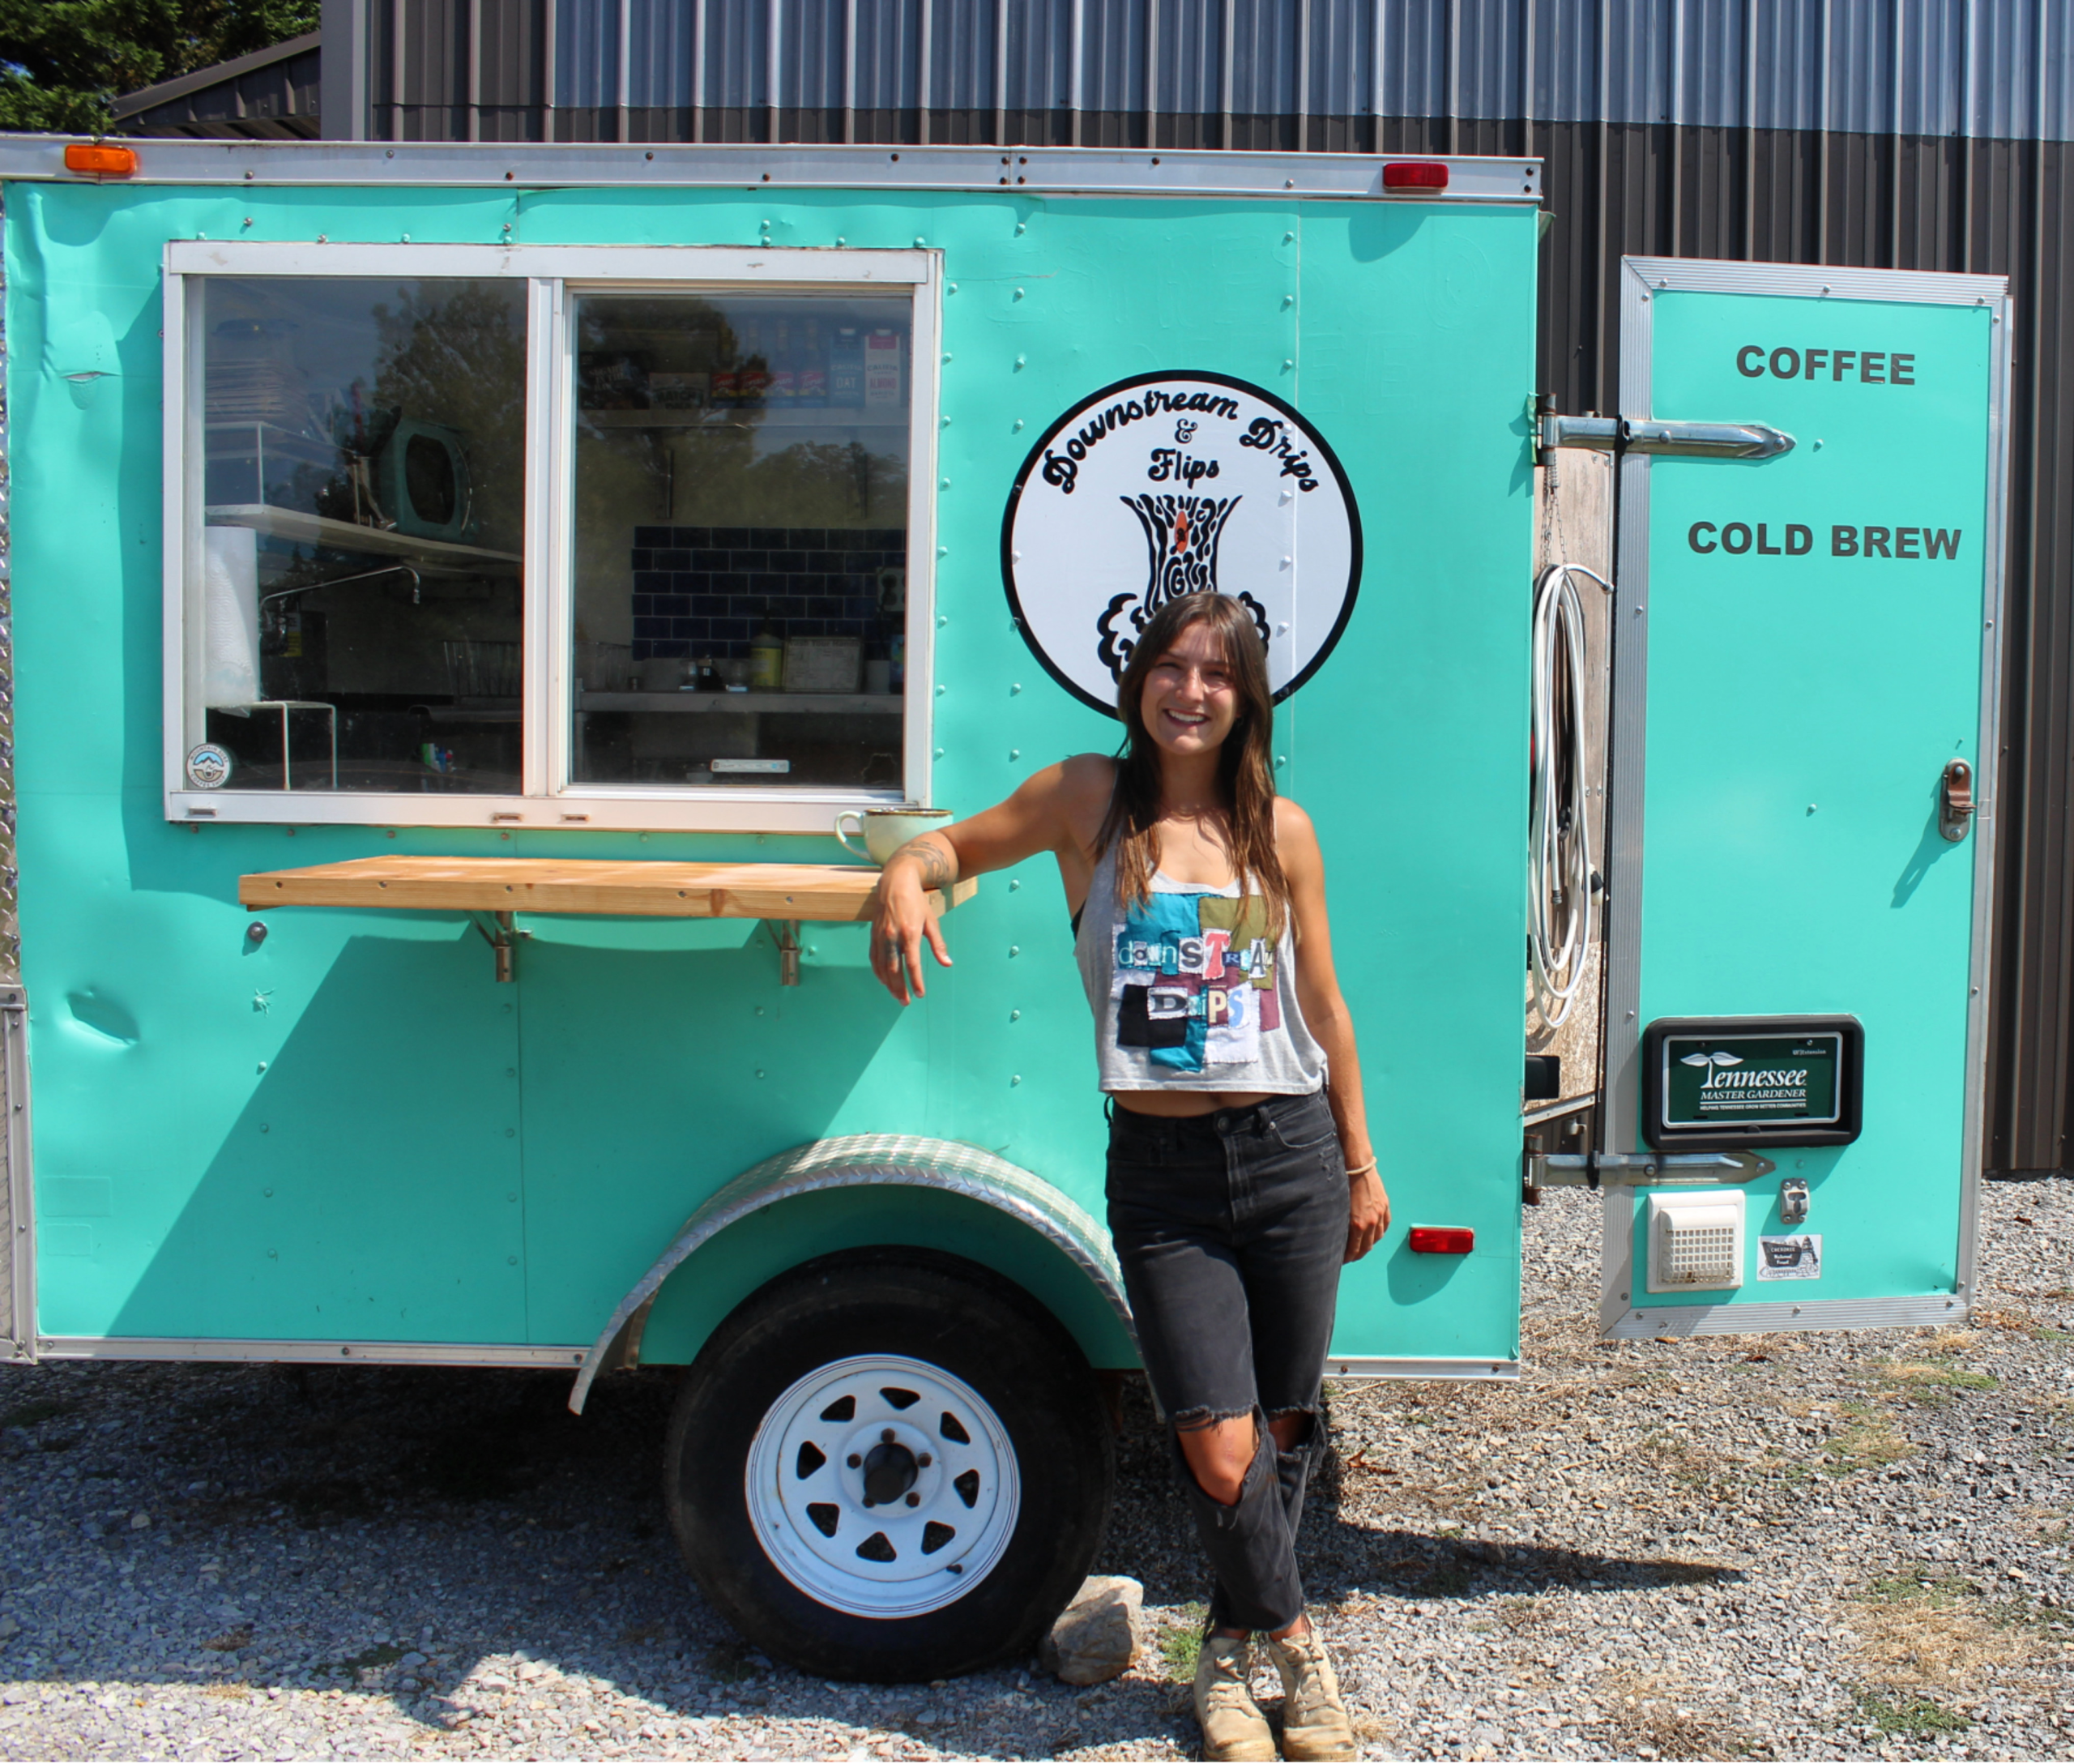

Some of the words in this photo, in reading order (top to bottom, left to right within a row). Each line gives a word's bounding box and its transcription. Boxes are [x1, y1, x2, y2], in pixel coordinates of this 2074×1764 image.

[836, 377, 856, 389] OAT
[1736, 345, 1915, 385] COFFEE
[1042, 390, 1238, 494] Downstream
[1239, 416, 1319, 492] Drips
[1174, 418, 1197, 443] &
[1147, 447, 1220, 489] Flips
[1688, 521, 1814, 555] COLD
[1831, 525, 1962, 560] BREW
[1695, 1053, 1807, 1089] Tennessee
[1701, 1091, 1745, 1100] MASTER
[1747, 1088, 1807, 1098] GARDENER
